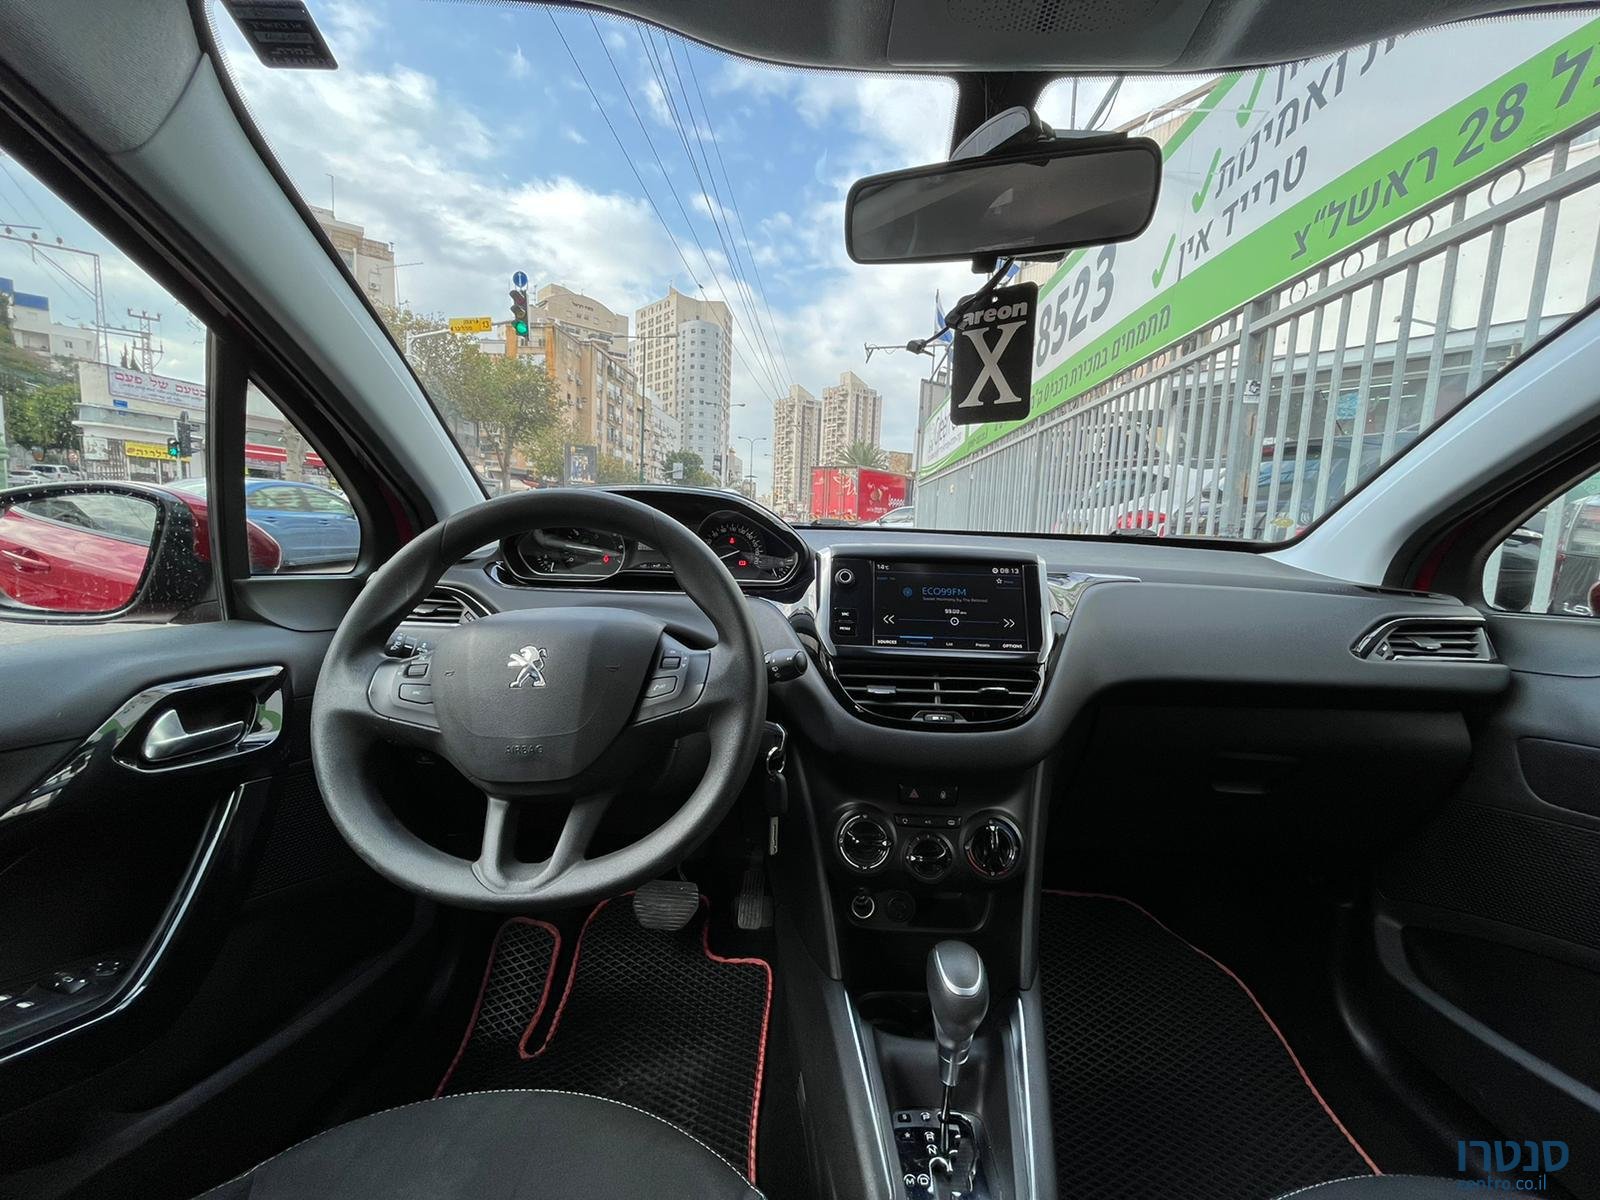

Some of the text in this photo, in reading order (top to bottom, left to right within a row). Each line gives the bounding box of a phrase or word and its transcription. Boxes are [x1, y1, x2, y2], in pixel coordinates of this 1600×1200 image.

[1215, 50, 1348, 199] ואמינות
[1453, 82, 1528, 167] 28
[1177, 145, 1307, 281] טרייד אין
[962, 302, 1028, 327] areon
[1111, 304, 1171, 361] מתמחים
[958, 320, 1027, 408] X
[1068, 347, 1108, 387] במכירת
[921, 587, 967, 596] ECO99FM
[505, 744, 544, 754] AIRBAG
